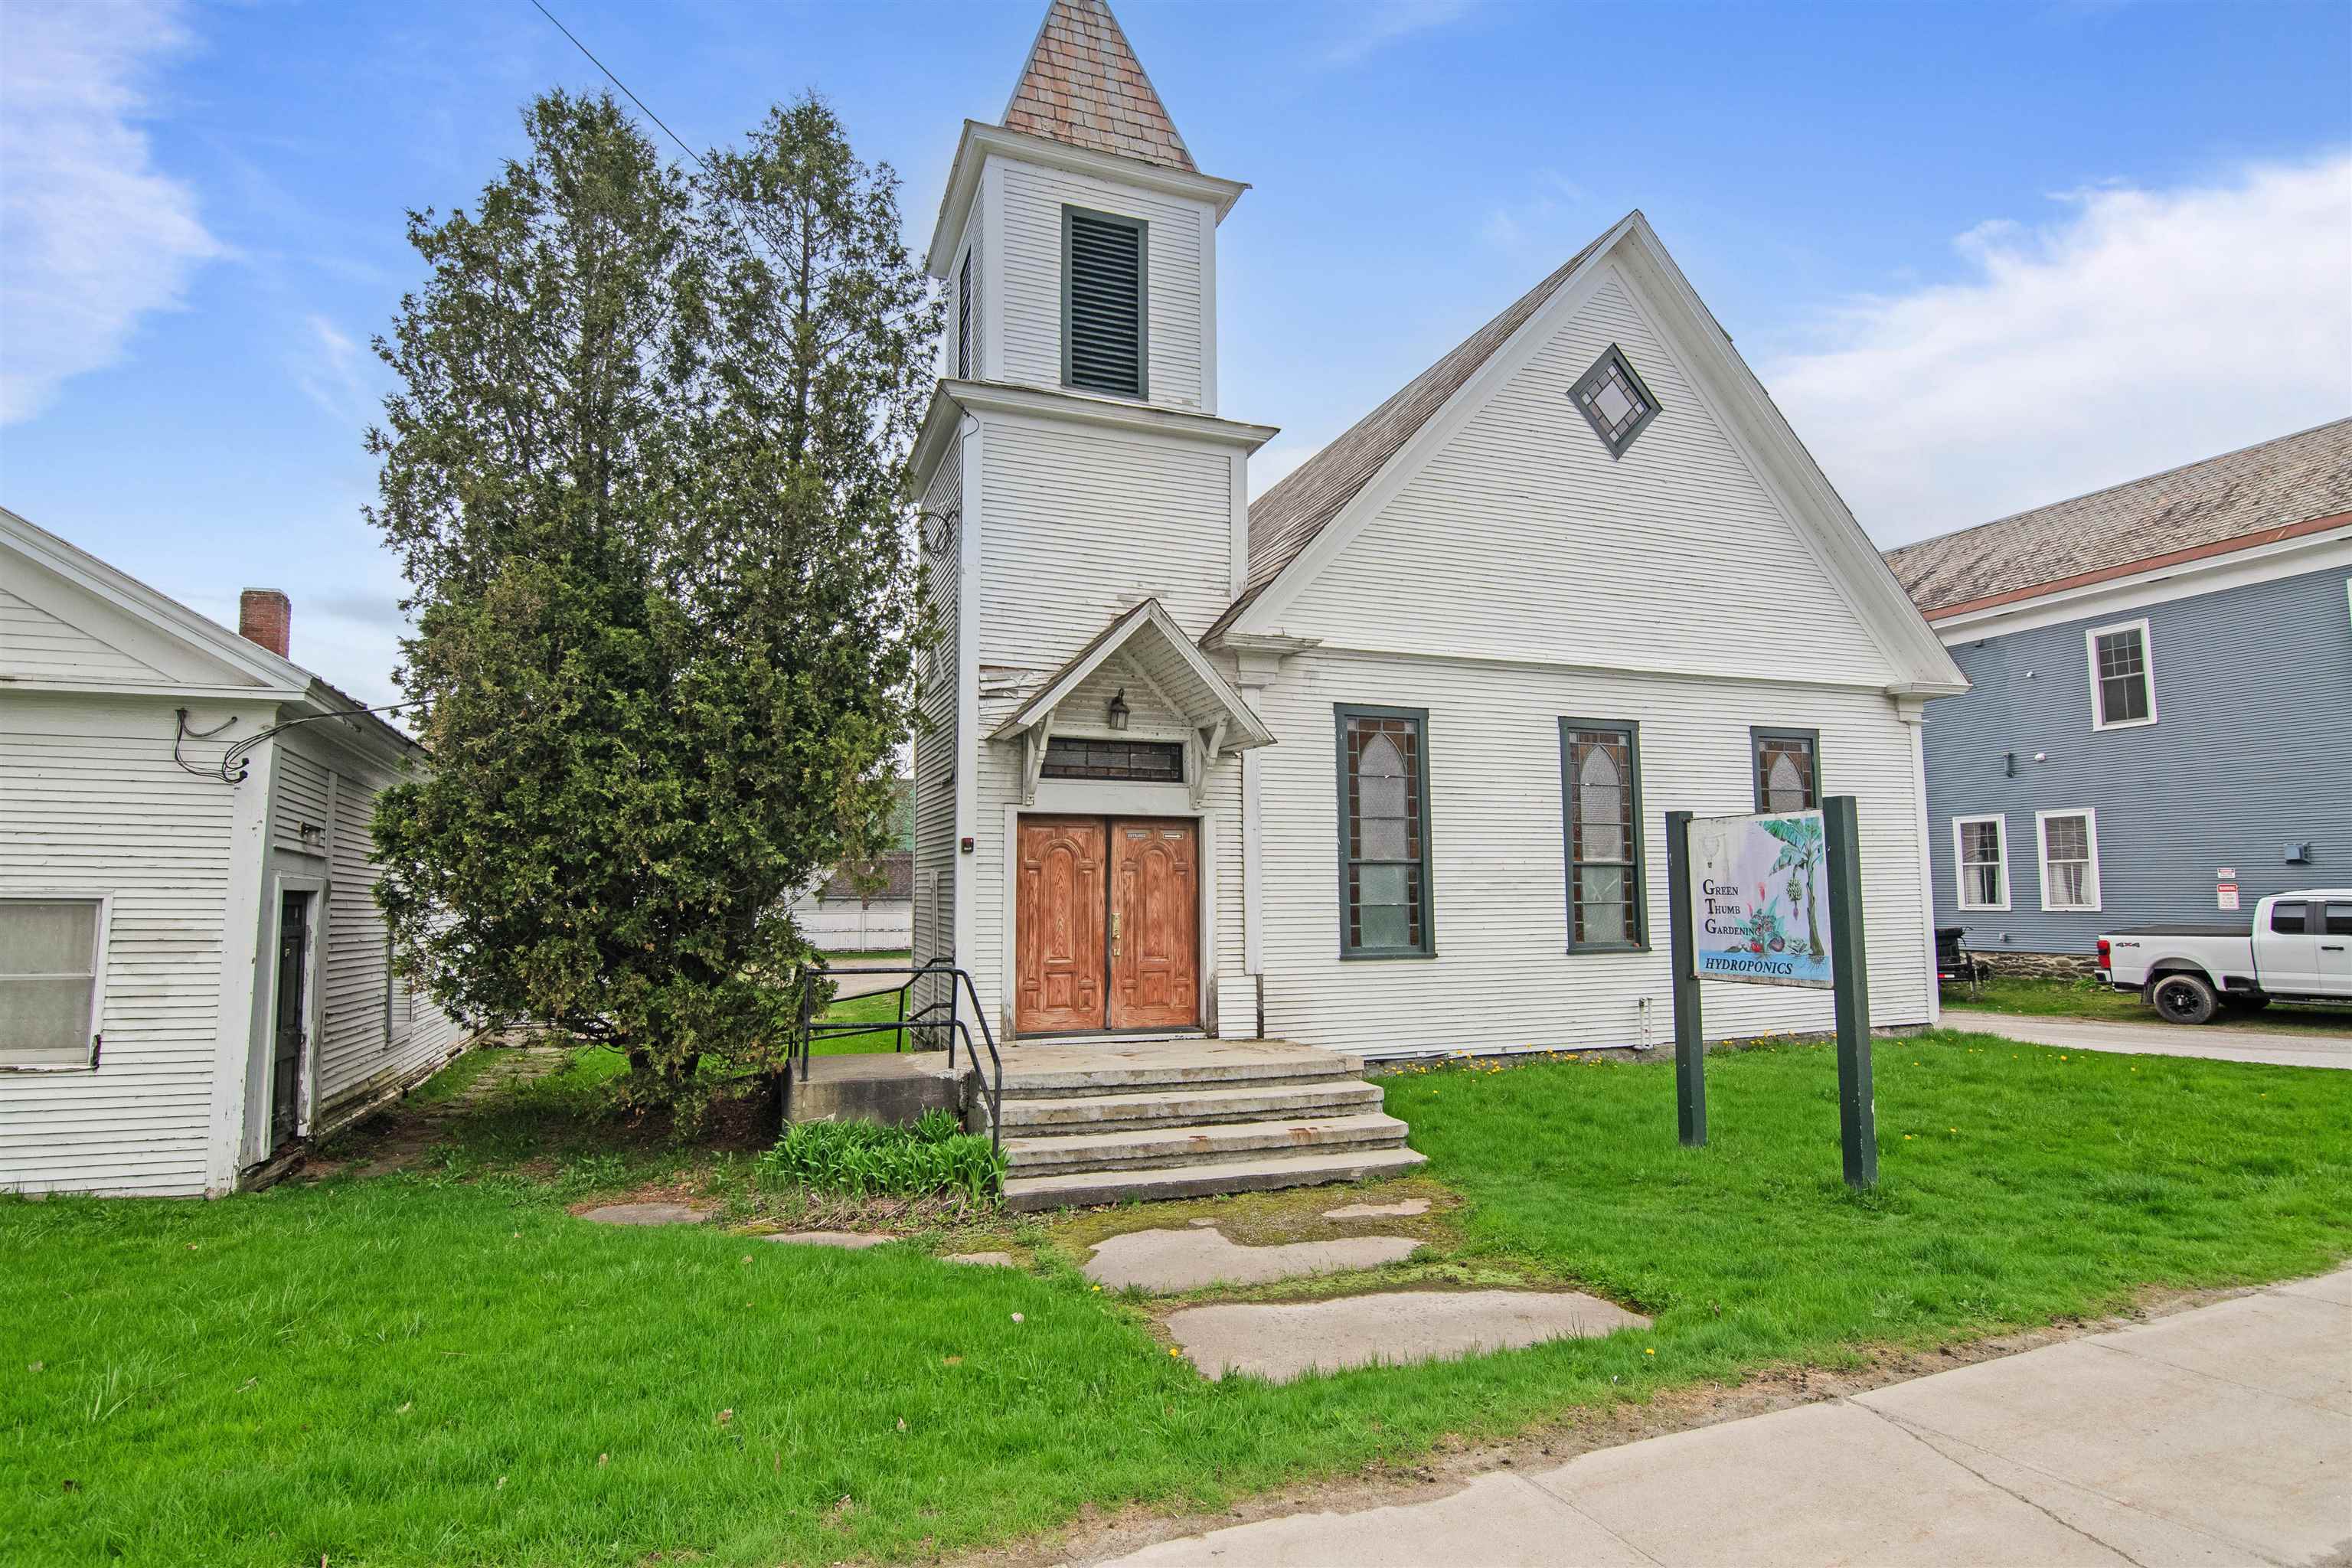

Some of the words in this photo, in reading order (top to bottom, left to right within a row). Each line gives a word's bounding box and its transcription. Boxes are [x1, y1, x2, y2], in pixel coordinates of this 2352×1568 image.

[1703, 879, 1739, 895] GREEN
[1705, 898, 1740, 914] THUMB
[1706, 957, 1793, 975] HYDROPONICS
